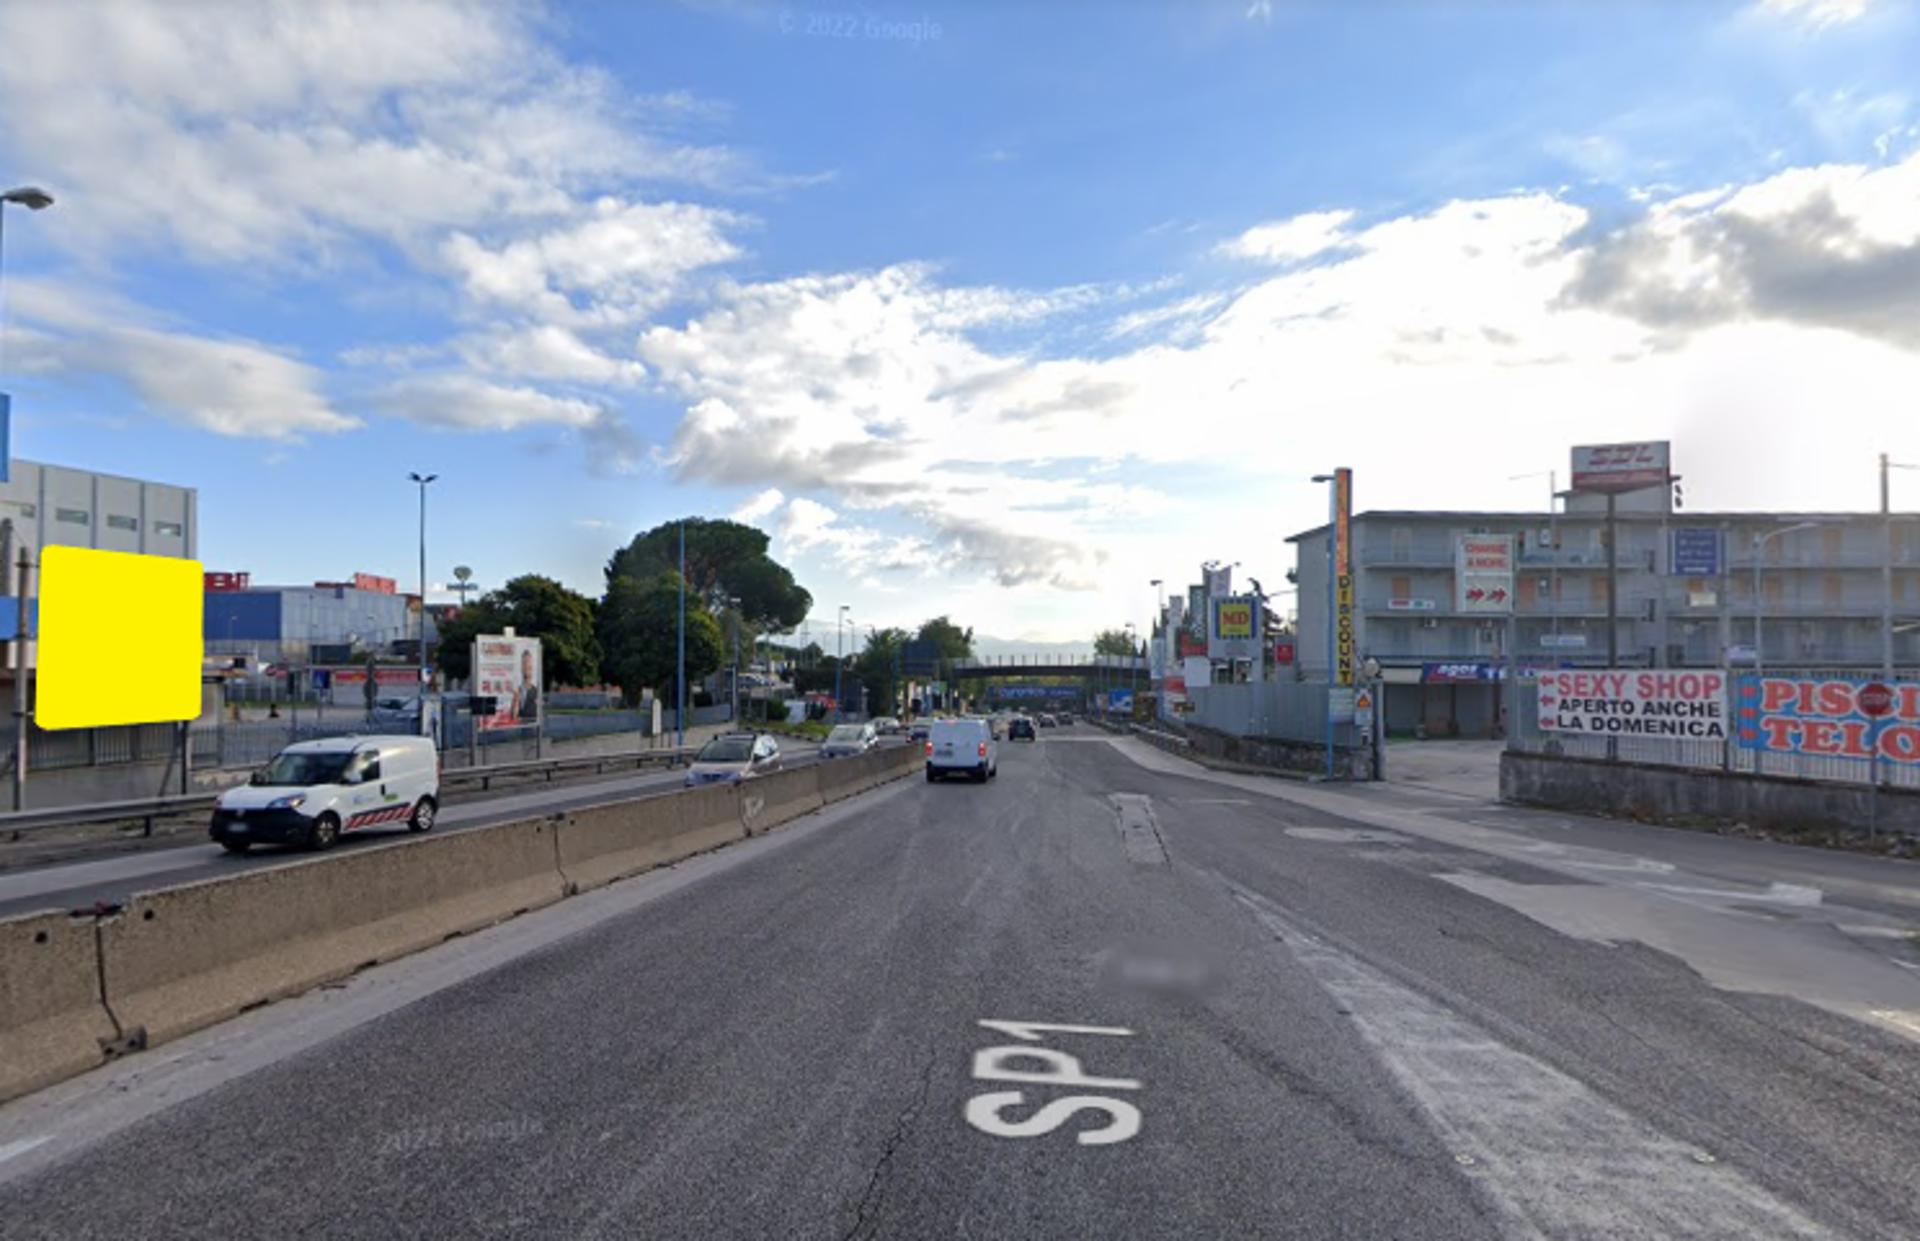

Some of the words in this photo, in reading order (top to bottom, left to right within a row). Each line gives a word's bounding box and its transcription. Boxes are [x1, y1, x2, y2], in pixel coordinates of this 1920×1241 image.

[1338, 575, 1351, 683] DISCOUNT
[1557, 673, 1627, 698] SEXY
[1637, 674, 1721, 700] SHOP
[1558, 698, 1635, 715] APERTO
[1642, 701, 1721, 718] ANCHE
[1557, 715, 1583, 730] LA
[1591, 716, 1724, 737] DOMENICA
[965, 1018, 1143, 1146] SP1
